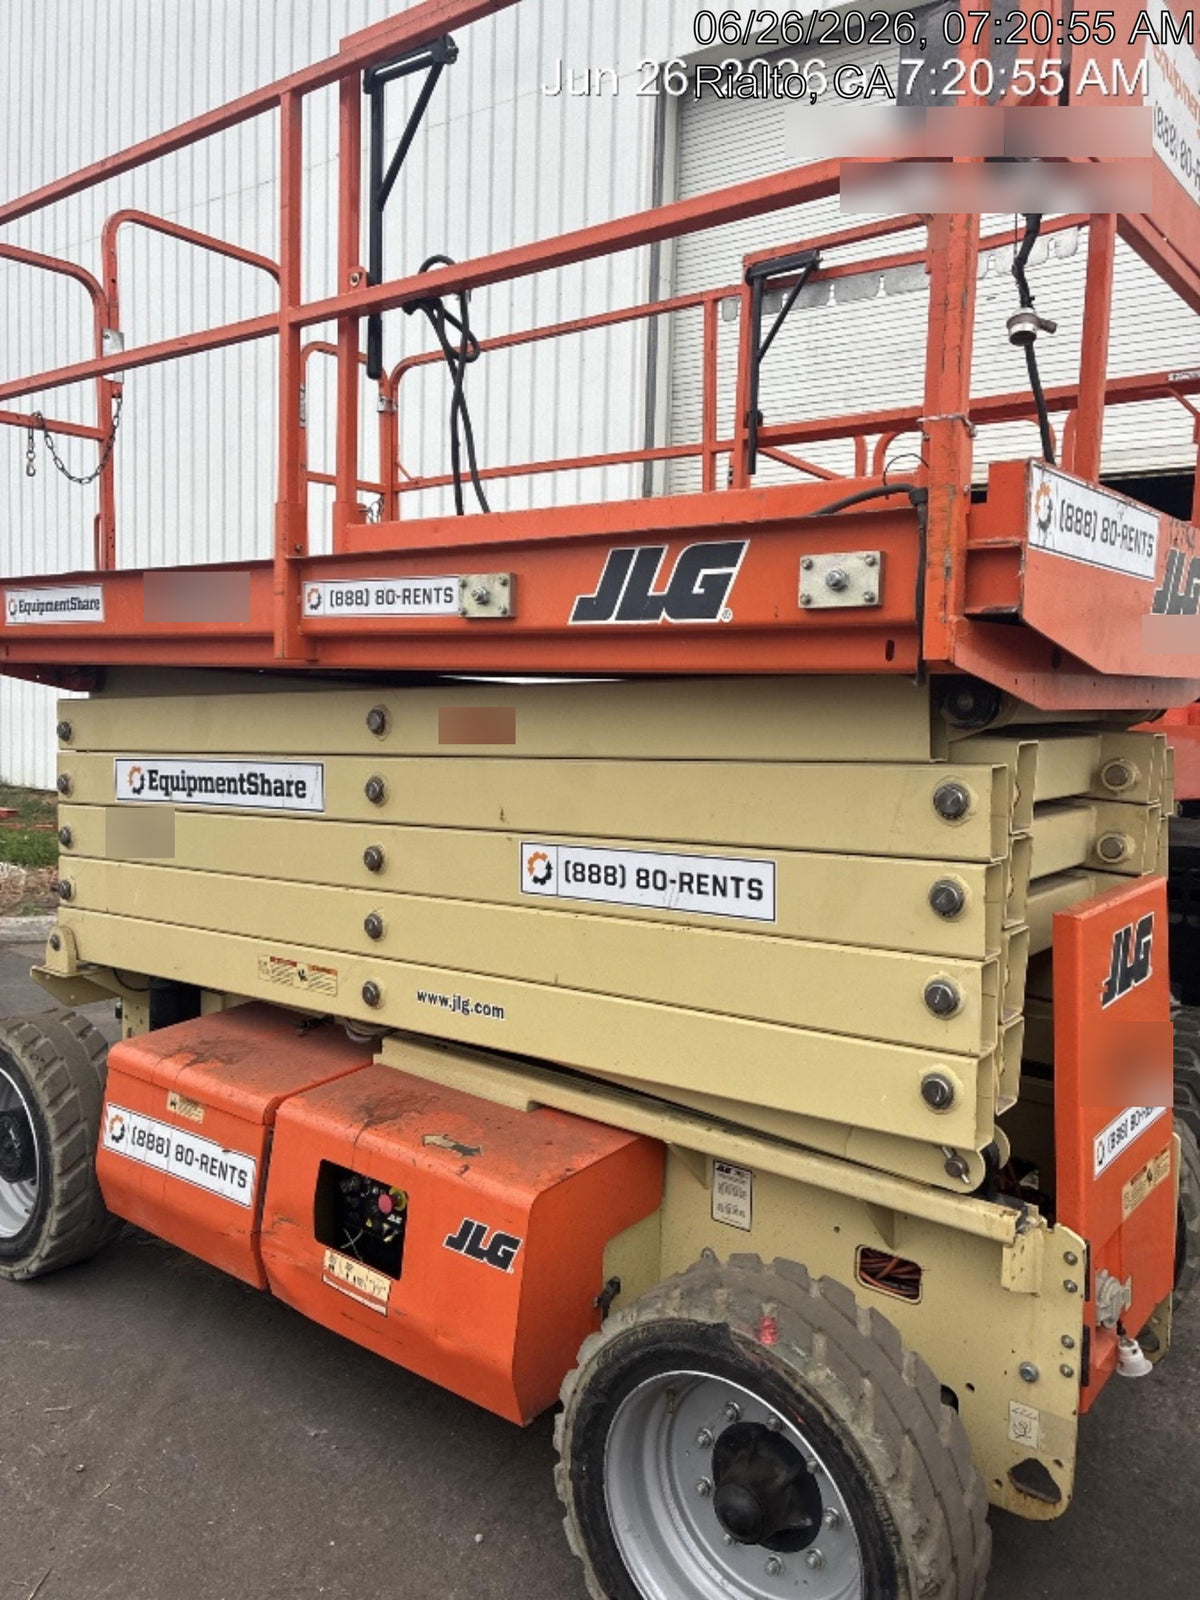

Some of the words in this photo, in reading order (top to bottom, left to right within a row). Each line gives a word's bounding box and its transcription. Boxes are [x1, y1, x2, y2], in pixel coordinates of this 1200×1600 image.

[1059, 499, 1098, 543] (888)
[1100, 516, 1155, 558] 80-RENTS
[18, 597, 100, 616] EquipmentShare
[329, 589, 370, 608] (888)
[375, 586, 454, 606] 80-RENTS
[568, 539, 750, 625] JLG
[147, 769, 307, 799] EquipmentShare
[564, 860, 626, 889] (888)
[636, 867, 764, 901] 80-RENTS
[1101, 911, 1155, 1010] JLG
[416, 989, 506, 1019] www.jlg.com
[131, 1126, 171, 1158] (888)
[175, 1143, 248, 1189] 80-RENTS
[442, 1216, 524, 1273] JLG
